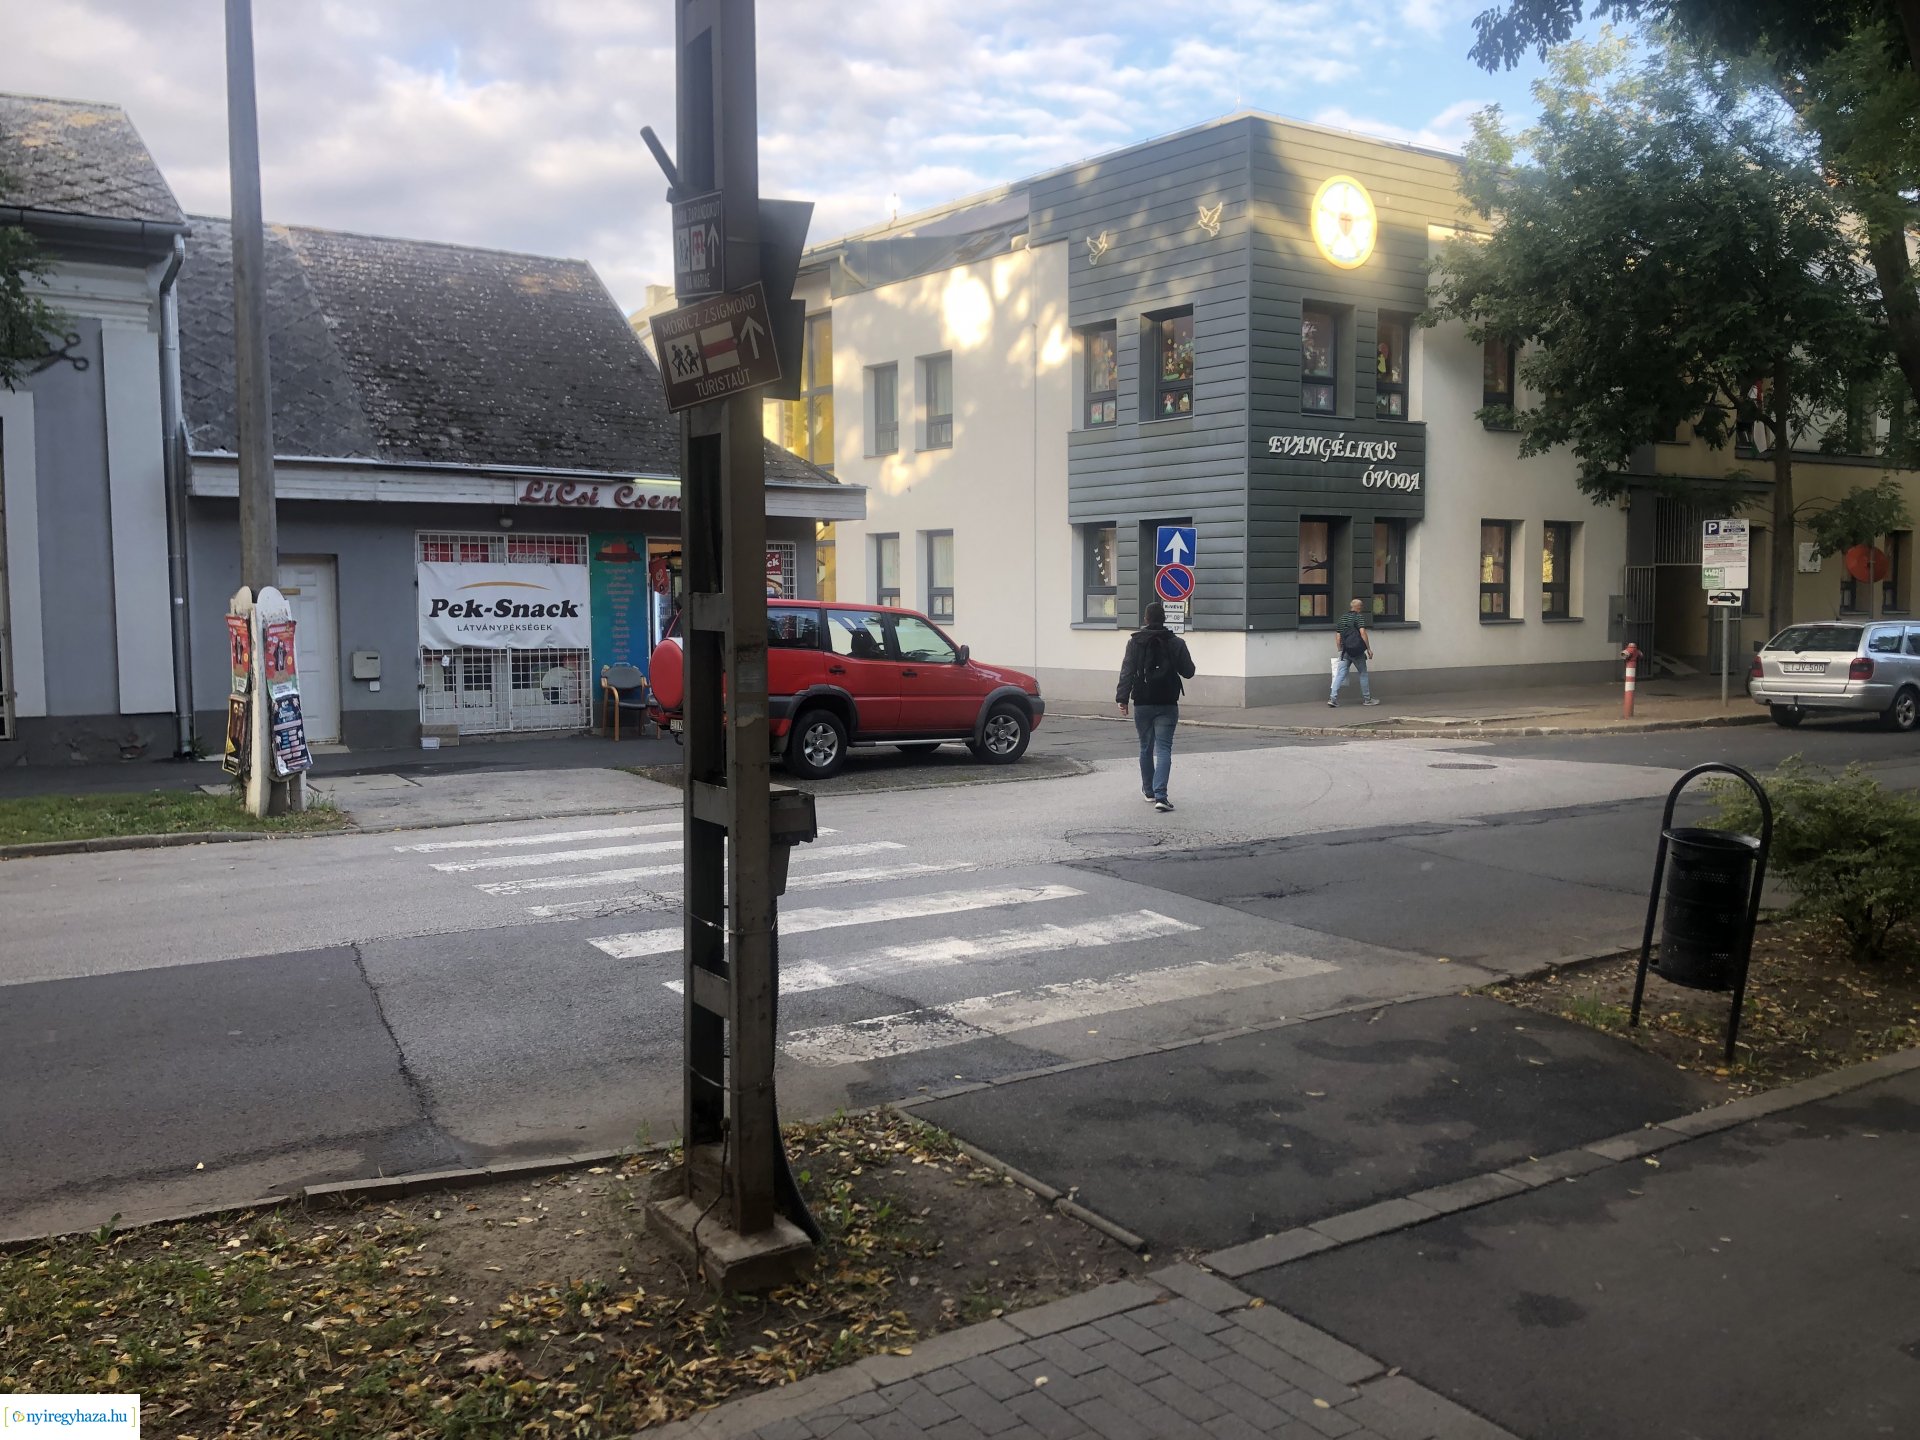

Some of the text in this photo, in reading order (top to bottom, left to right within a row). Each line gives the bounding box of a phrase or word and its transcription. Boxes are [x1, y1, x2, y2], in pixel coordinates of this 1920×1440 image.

[704, 294, 756, 324] ZSIGMOND
[1268, 432, 1398, 463] EVANGÉLIKUS
[1362, 465, 1420, 492] ÓVODA
[519, 478, 681, 510] LiCsi Csem
[429, 598, 579, 619] Pek-Snack
[457, 623, 553, 632] LÁTVÁNYPÉKSÉGEK
